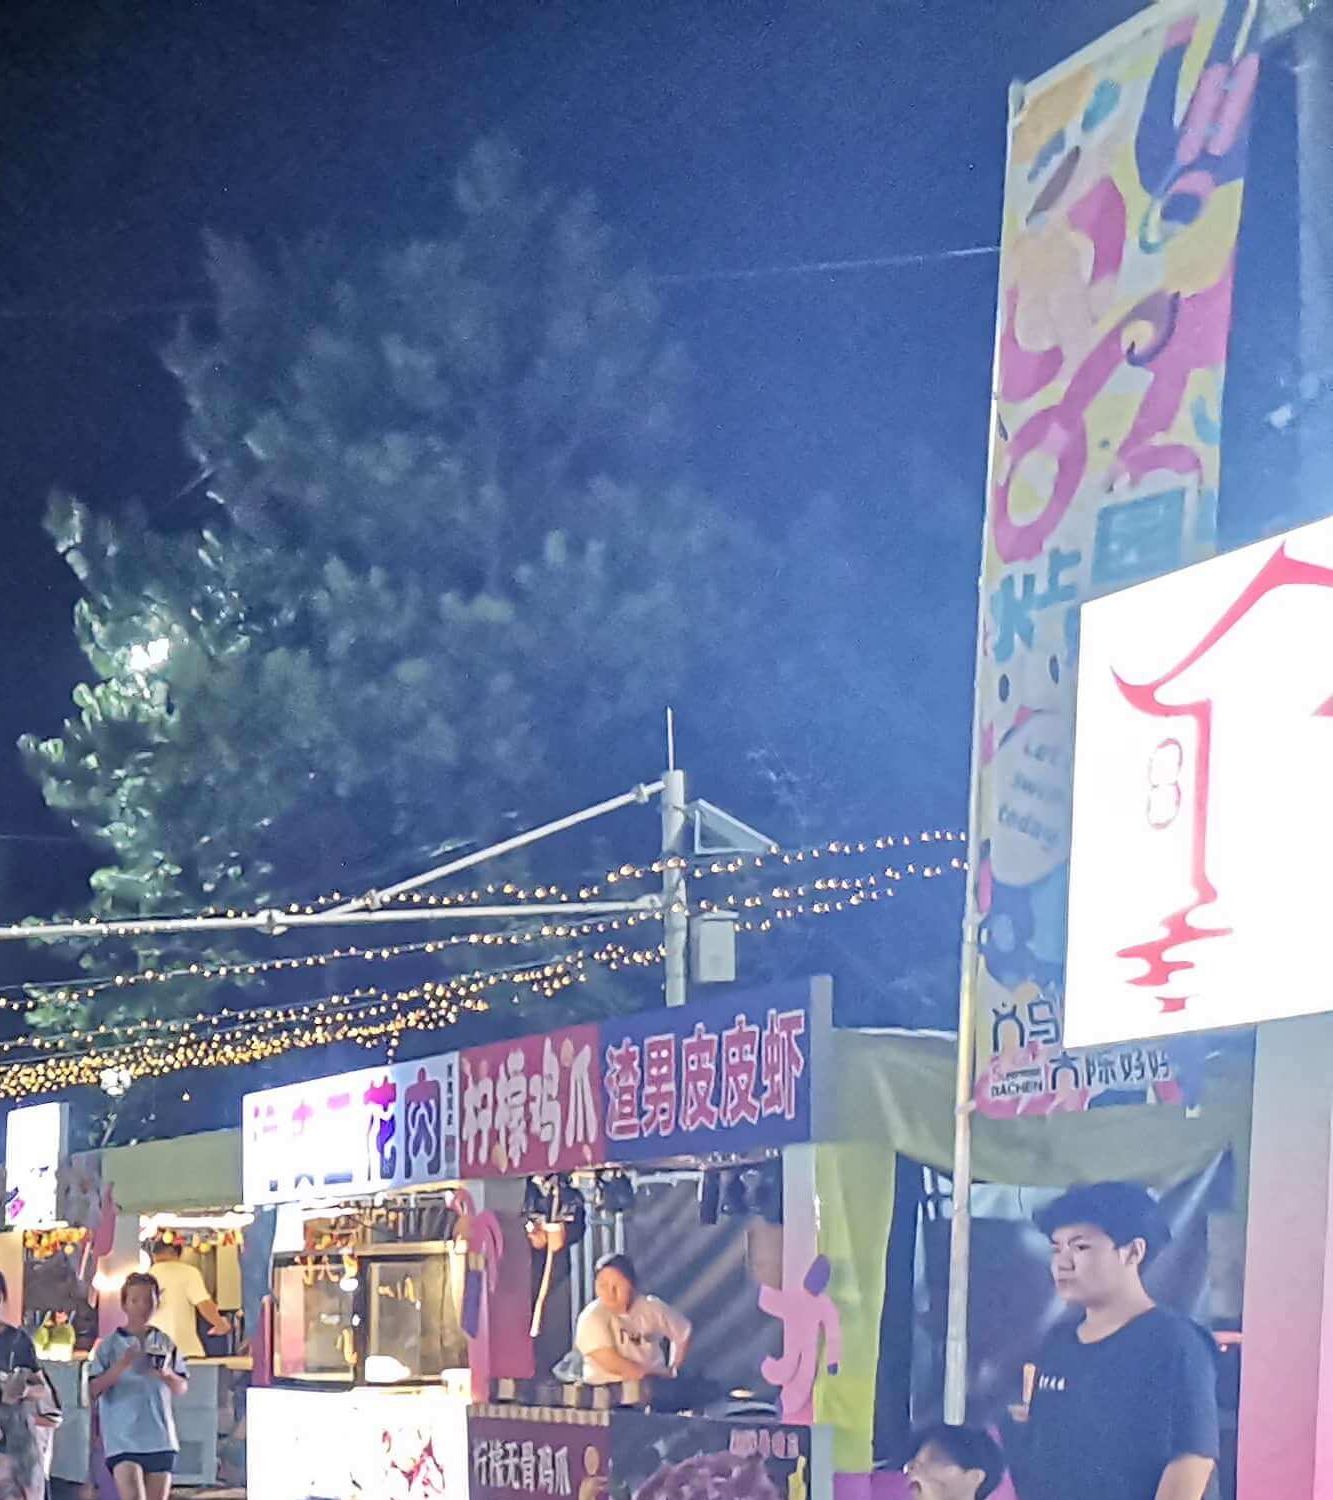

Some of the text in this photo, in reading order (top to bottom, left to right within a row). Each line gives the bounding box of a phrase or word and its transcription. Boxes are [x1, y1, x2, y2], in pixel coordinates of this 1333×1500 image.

[462, 1037, 599, 1168] 柠檬鸡爪
[605, 1008, 805, 1140] 渣男皮皮虾
